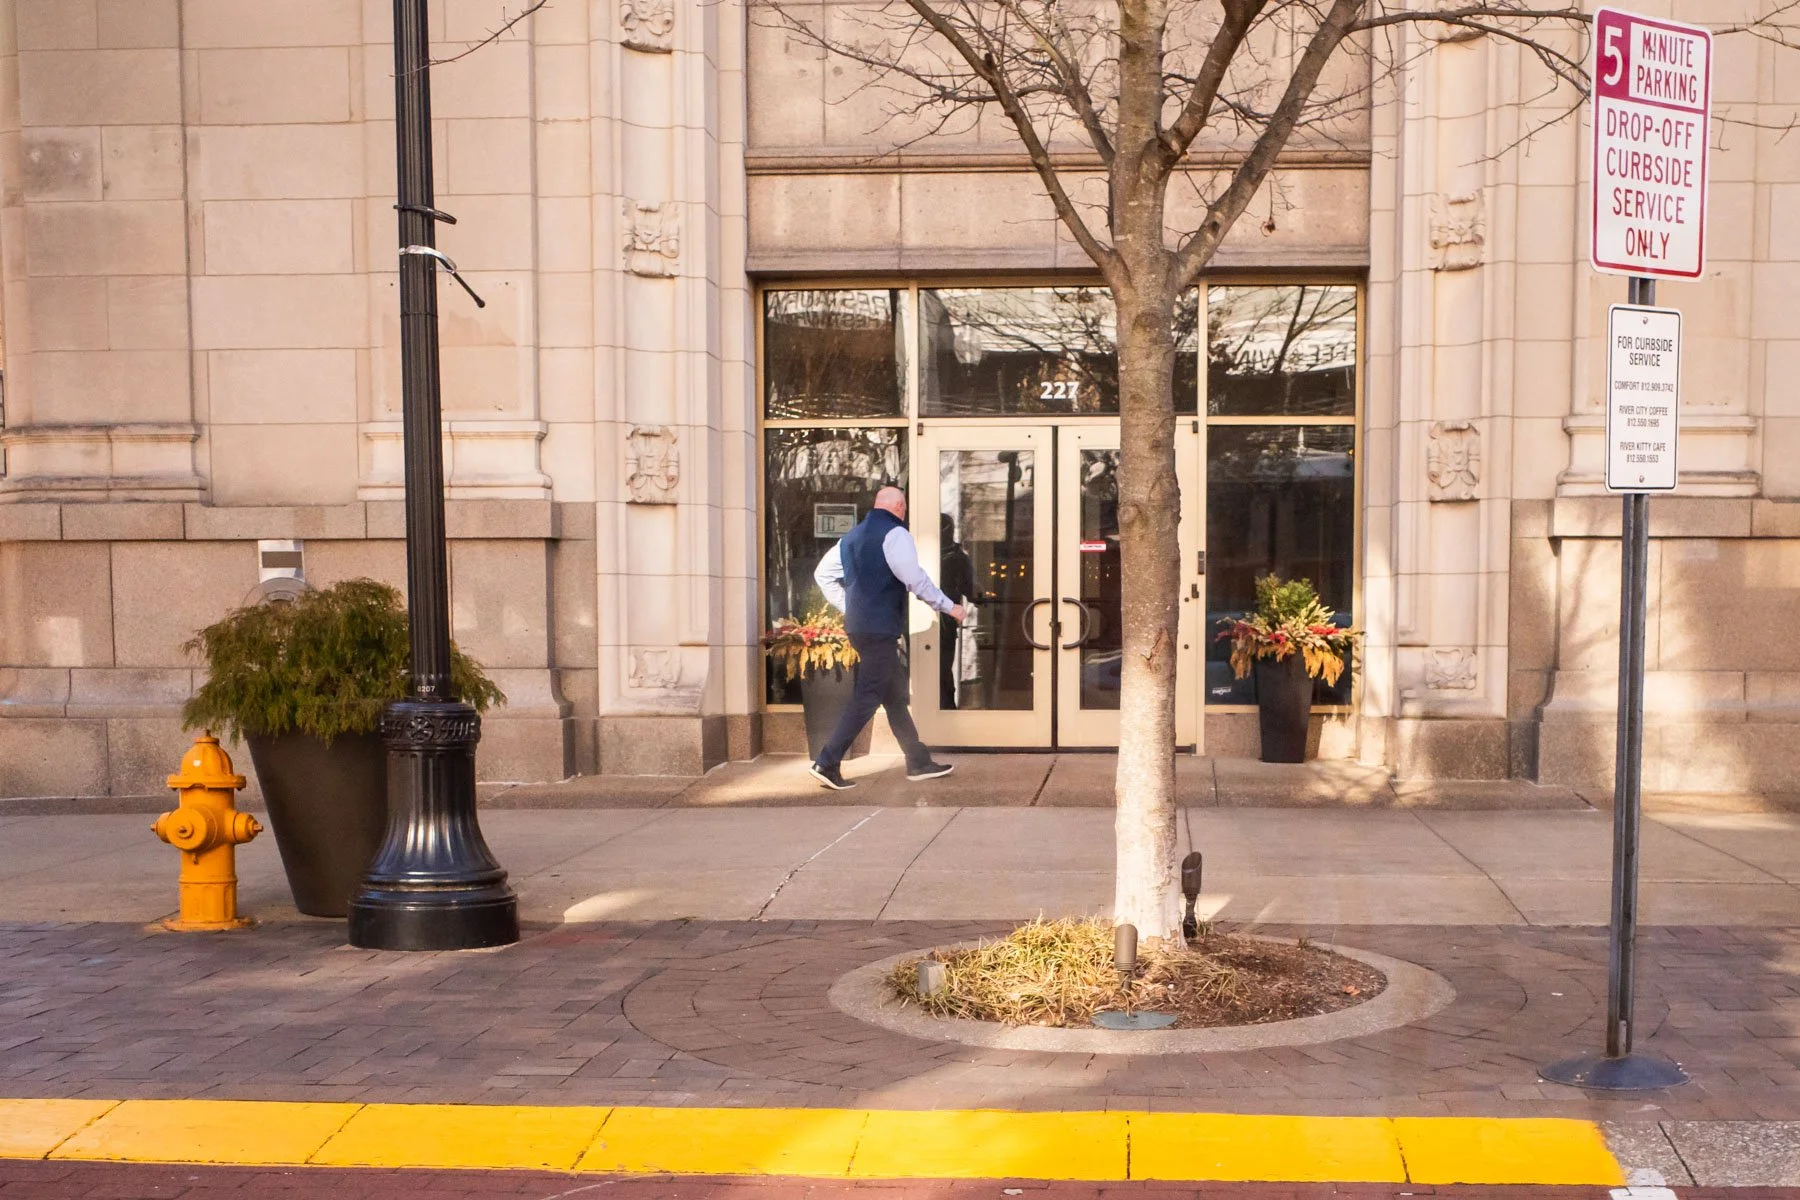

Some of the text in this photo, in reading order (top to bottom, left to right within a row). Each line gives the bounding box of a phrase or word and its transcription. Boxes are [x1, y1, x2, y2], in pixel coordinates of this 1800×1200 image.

[1603, 25, 1623, 86] 5
[1642, 30, 1694, 68] MINUTE
[1636, 65, 1697, 104] PARKING
[1606, 108, 1695, 150] DROP-OFF
[1606, 147, 1693, 188] CURBSIDE
[1612, 187, 1685, 224] SERVICE
[1625, 227, 1671, 260] ONLY
[1617, 336, 1673, 352] FOR CURBSIDE
[1629, 353, 1660, 367] SERVICE
[1040, 381, 1079, 399] 227
[1614, 381, 1639, 391] COMFORT
[1619, 405, 1668, 416] RIVER CITY COFFEE
[1619, 442, 1666, 452] RIVER KITTY CAFE
